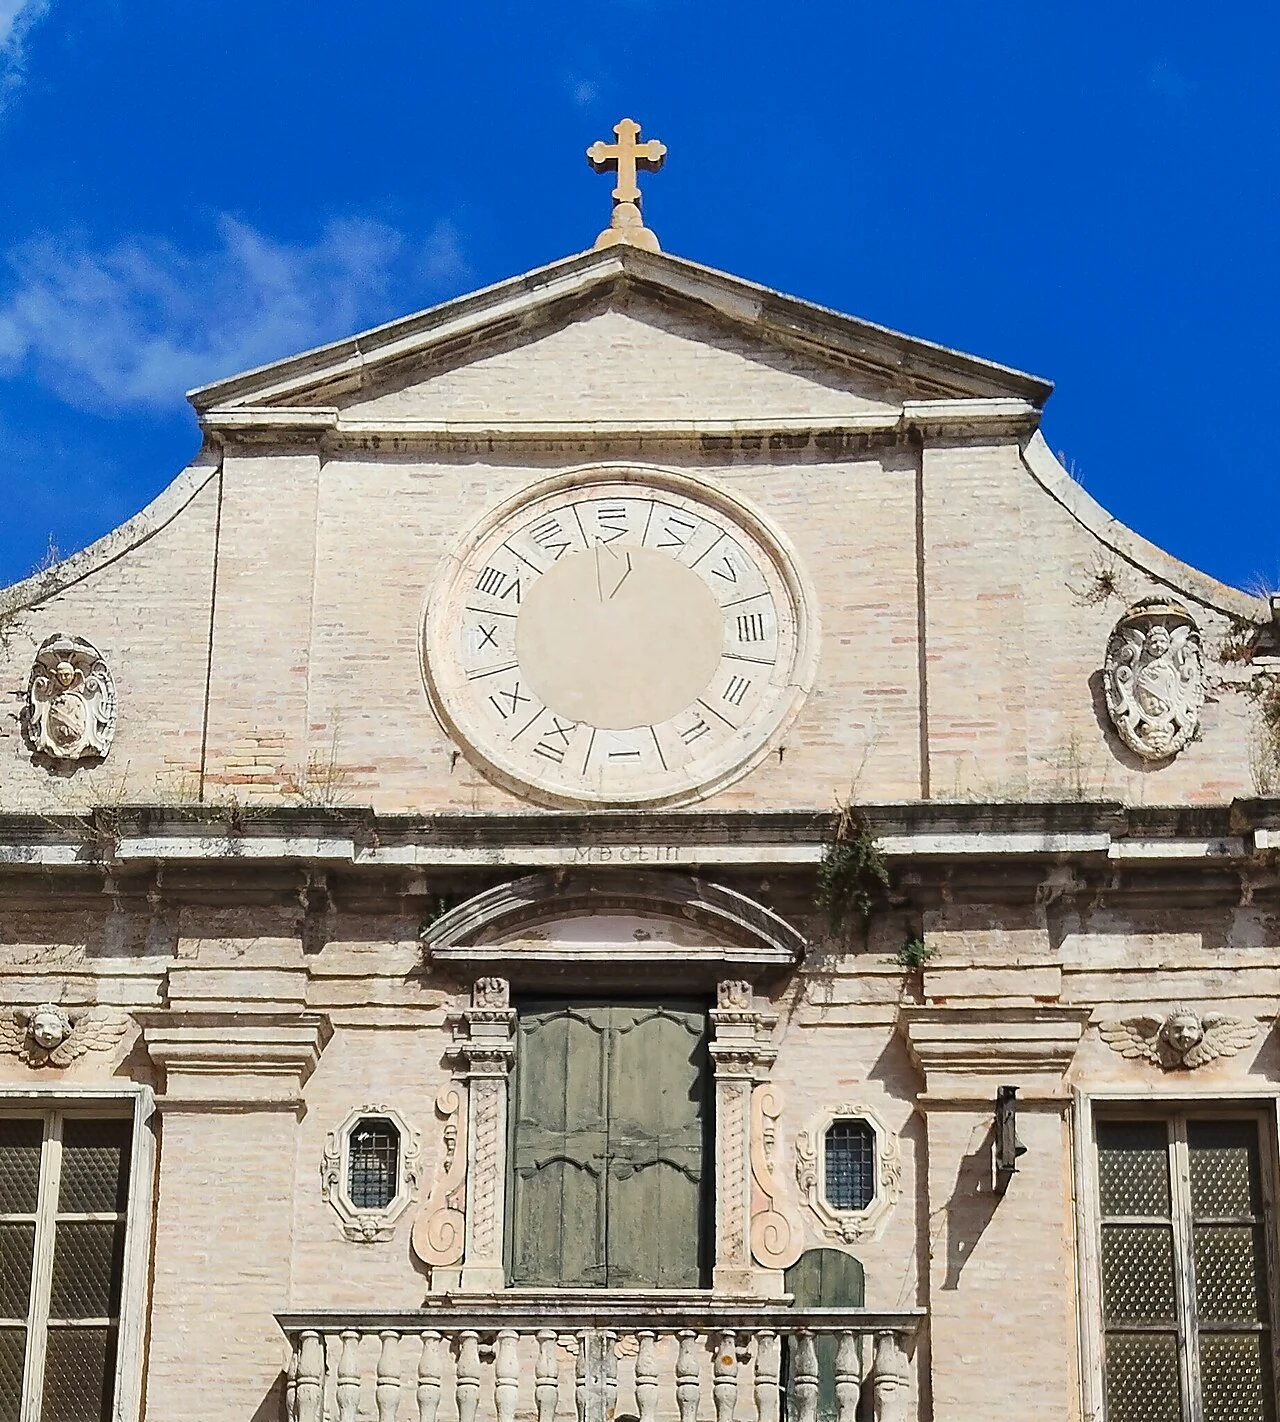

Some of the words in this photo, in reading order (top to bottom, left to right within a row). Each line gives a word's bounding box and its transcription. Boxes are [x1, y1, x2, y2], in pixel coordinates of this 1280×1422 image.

[477, 624, 499, 650] X
[736, 613, 765, 642] IIII
[722, 675, 751, 706] III
